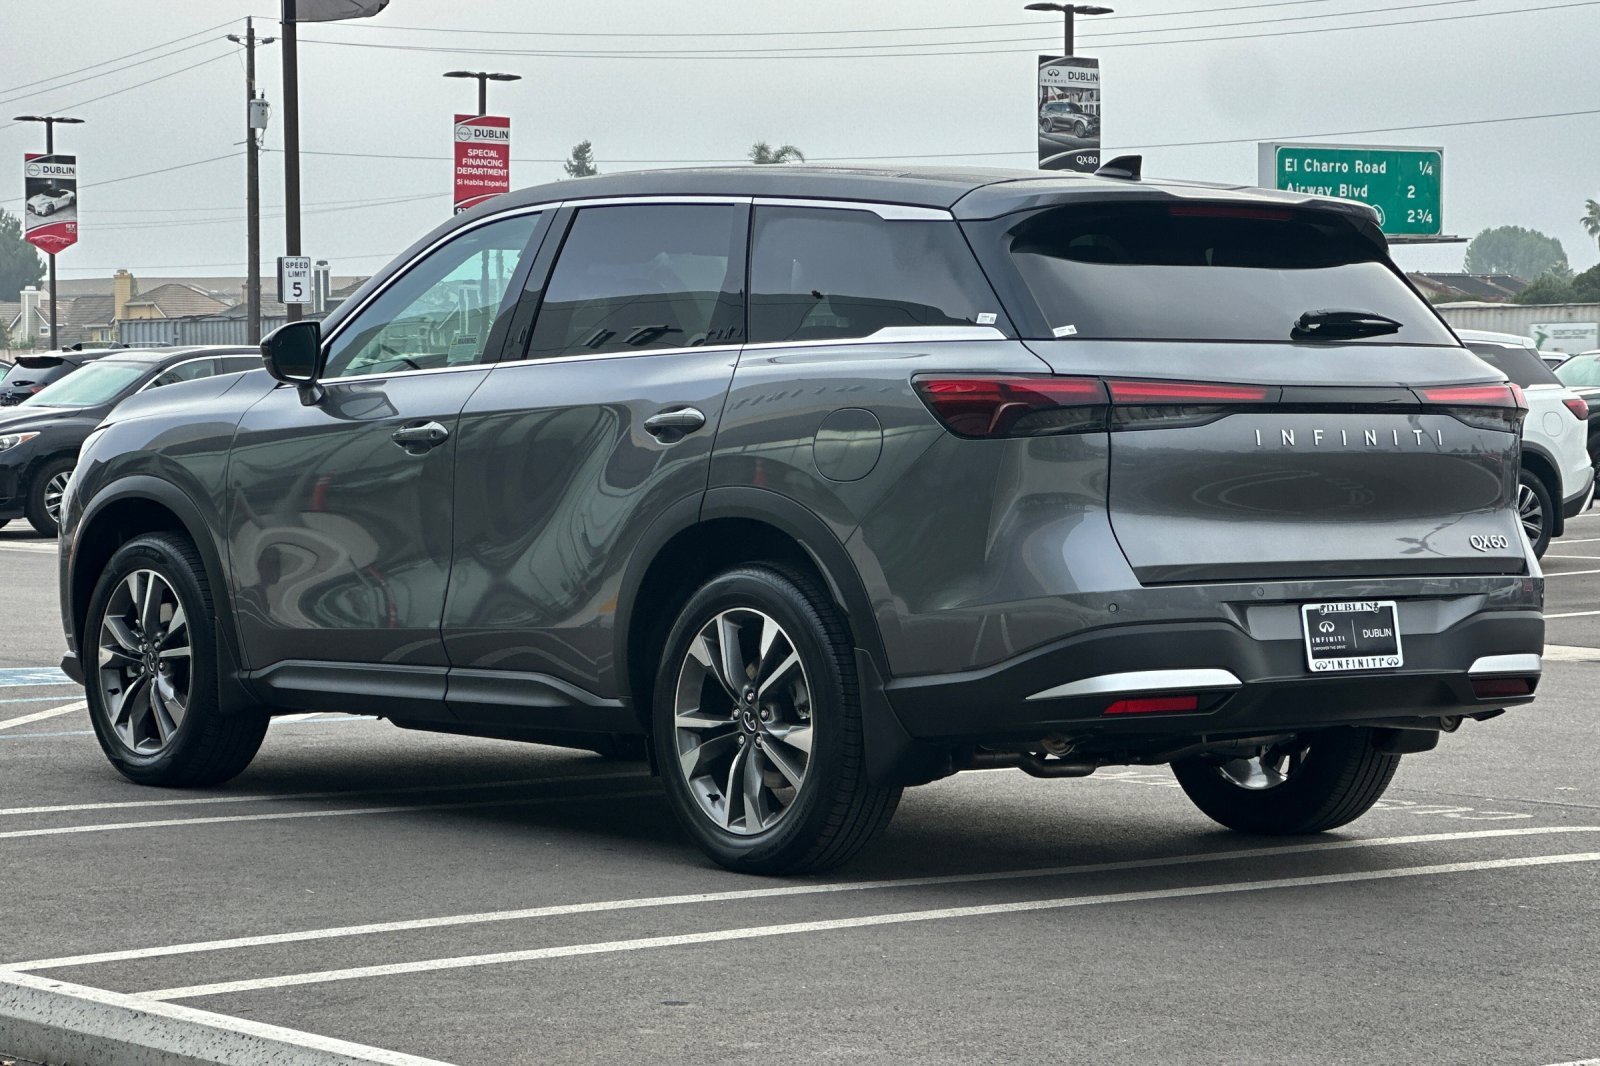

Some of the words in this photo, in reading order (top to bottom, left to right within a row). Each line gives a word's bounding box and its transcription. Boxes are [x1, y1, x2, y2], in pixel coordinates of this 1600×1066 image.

[1068, 72, 1098, 81] DUBLIN
[474, 129, 509, 139] DUBLIN
[468, 148, 498, 158] SPECIAL
[462, 158, 503, 167] FINANCING
[1076, 156, 1098, 165] QX80
[43, 166, 75, 174] DUBLIN
[1285, 158, 1297, 172] El
[1304, 159, 1348, 173] Charro
[1355, 160, 1386, 174] Road
[457, 167, 508, 176] DEPARTMENT
[1286, 182, 1332, 196] Airway
[1340, 184, 1368, 198] Blvd
[1407, 186, 1416, 198] 2
[1407, 210, 1416, 223] 2
[292, 282, 302, 297] 5
[1254, 429, 1442, 446] INFINITI
[1470, 534, 1508, 551] QX60
[1326, 602, 1373, 612] DUBLIN
[1362, 628, 1392, 638] DUBLIN
[1312, 635, 1346, 644] INFINITI
